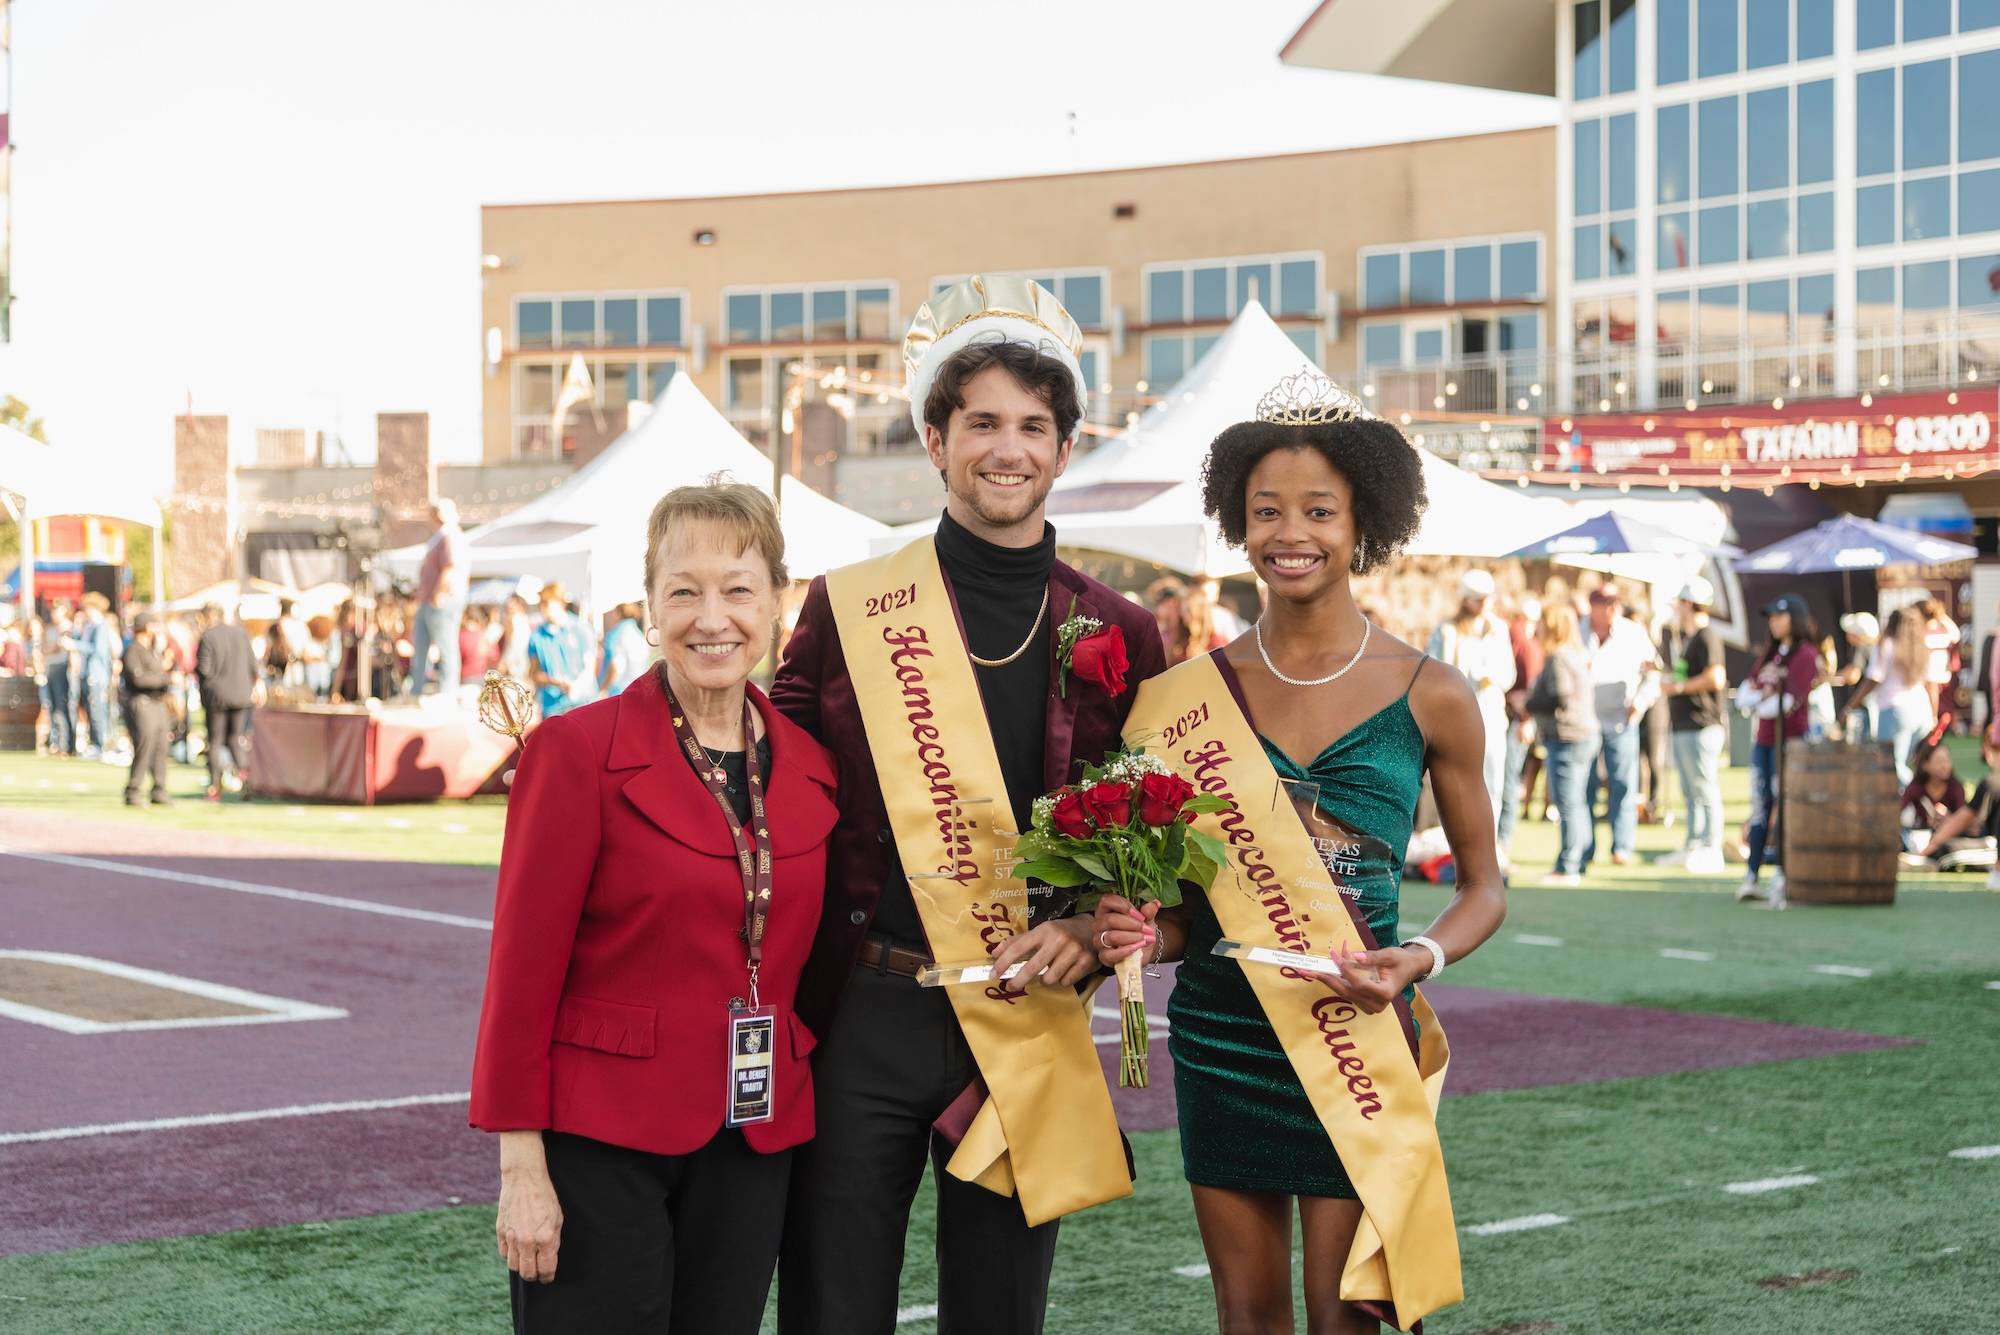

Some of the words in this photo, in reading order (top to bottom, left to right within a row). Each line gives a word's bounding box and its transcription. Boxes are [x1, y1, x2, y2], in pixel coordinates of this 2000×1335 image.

[1741, 420, 1858, 463] TXFARM
[1862, 422, 1892, 454] to
[1895, 411, 1990, 454] 83200
[865, 583, 916, 617] 2021
[1163, 701, 1209, 749] 2021
[883, 625, 981, 887] Homecoming
[971, 902, 1029, 1005] Kg
[1310, 836, 1361, 857] TEXAS
[1305, 855, 1358, 876] SATE
[1295, 876, 1363, 901] Homming
[1310, 995, 1383, 1121] Queen
[738, 1071, 748, 1081] DR.
